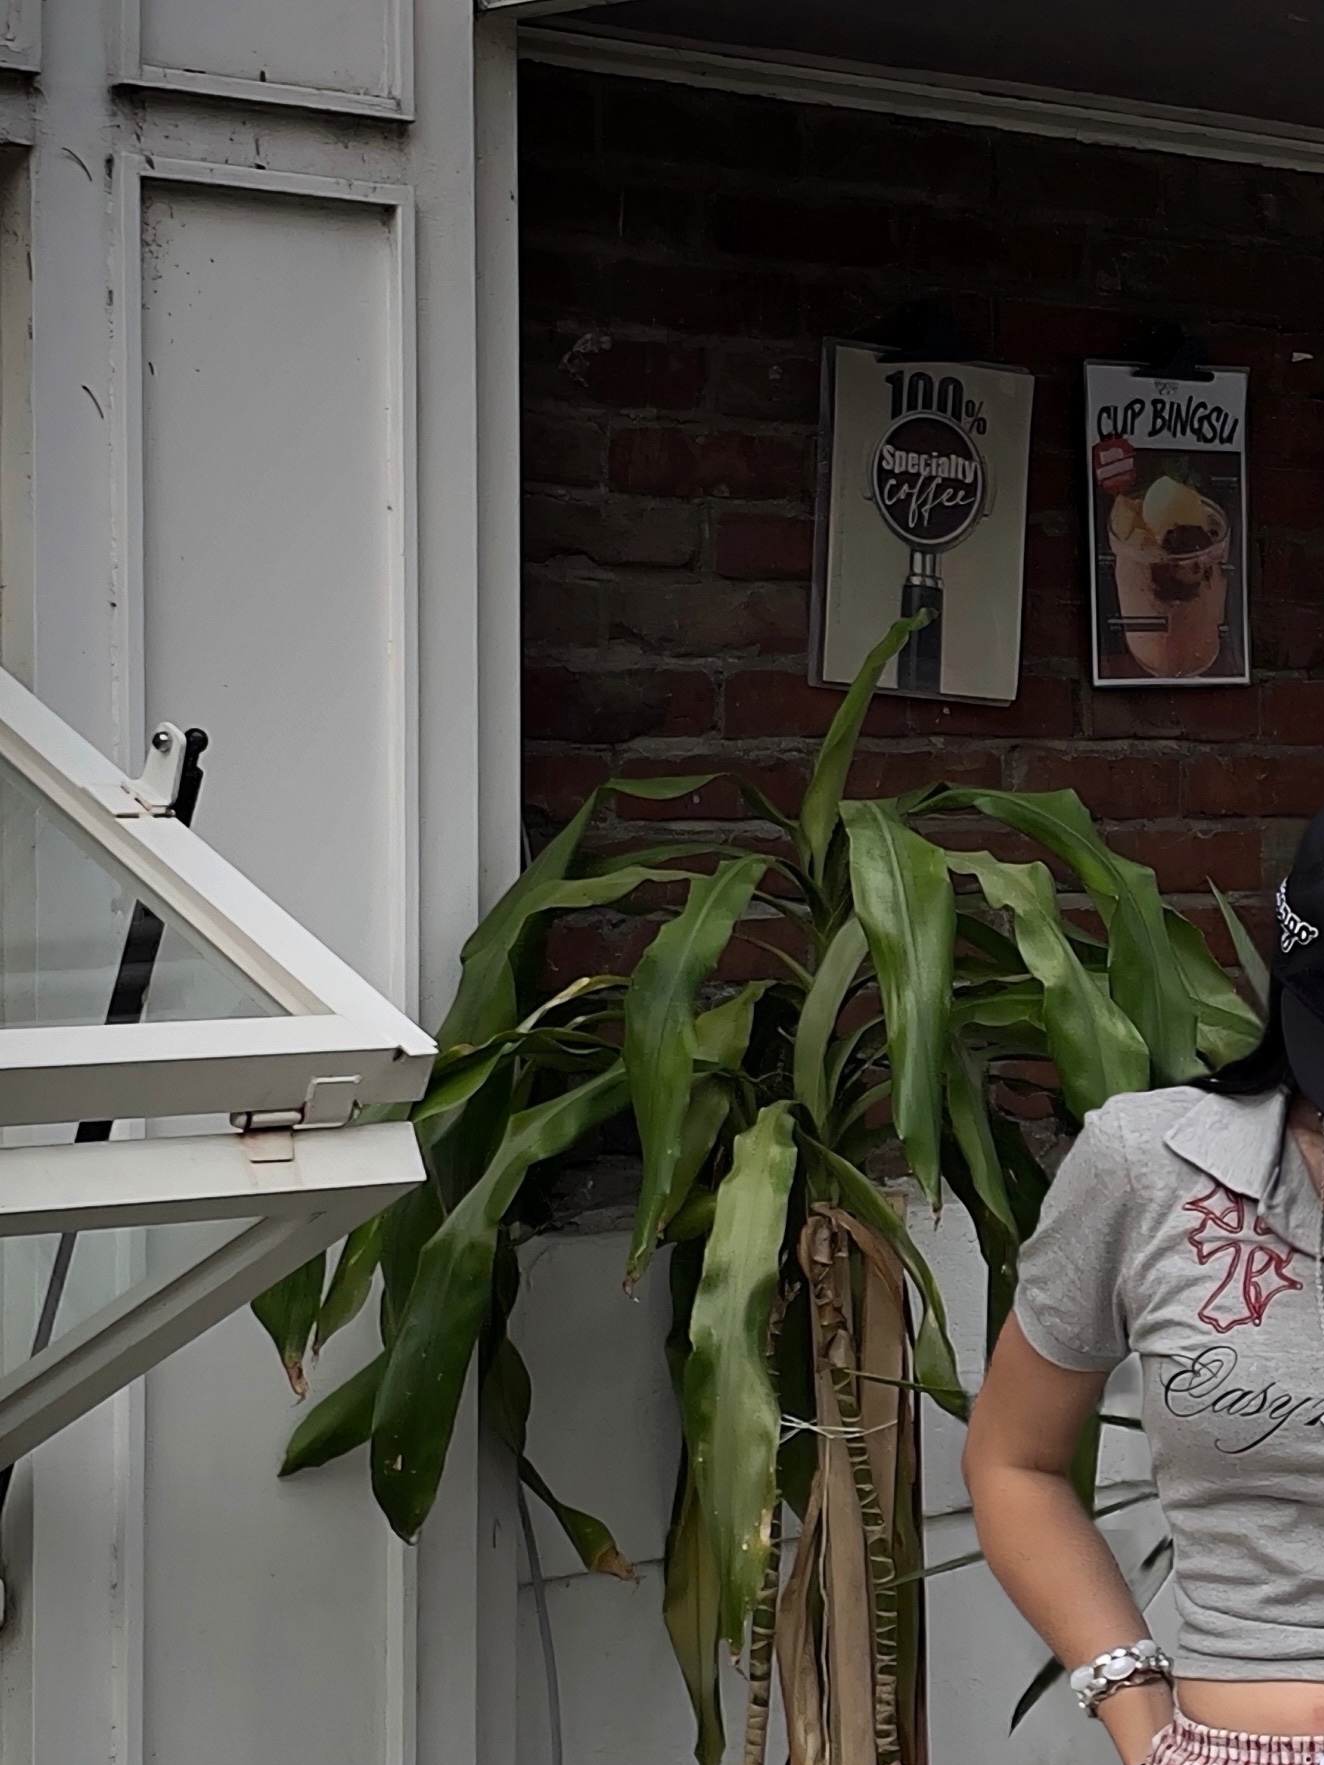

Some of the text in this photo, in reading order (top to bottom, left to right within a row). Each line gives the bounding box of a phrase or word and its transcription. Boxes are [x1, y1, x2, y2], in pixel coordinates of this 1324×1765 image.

[885, 370, 987, 434] 100%
[1097, 395, 1238, 445] CUP BINGSU
[881, 444, 977, 484] Specialty
[1159, 1346, 1312, 1454] Easy
